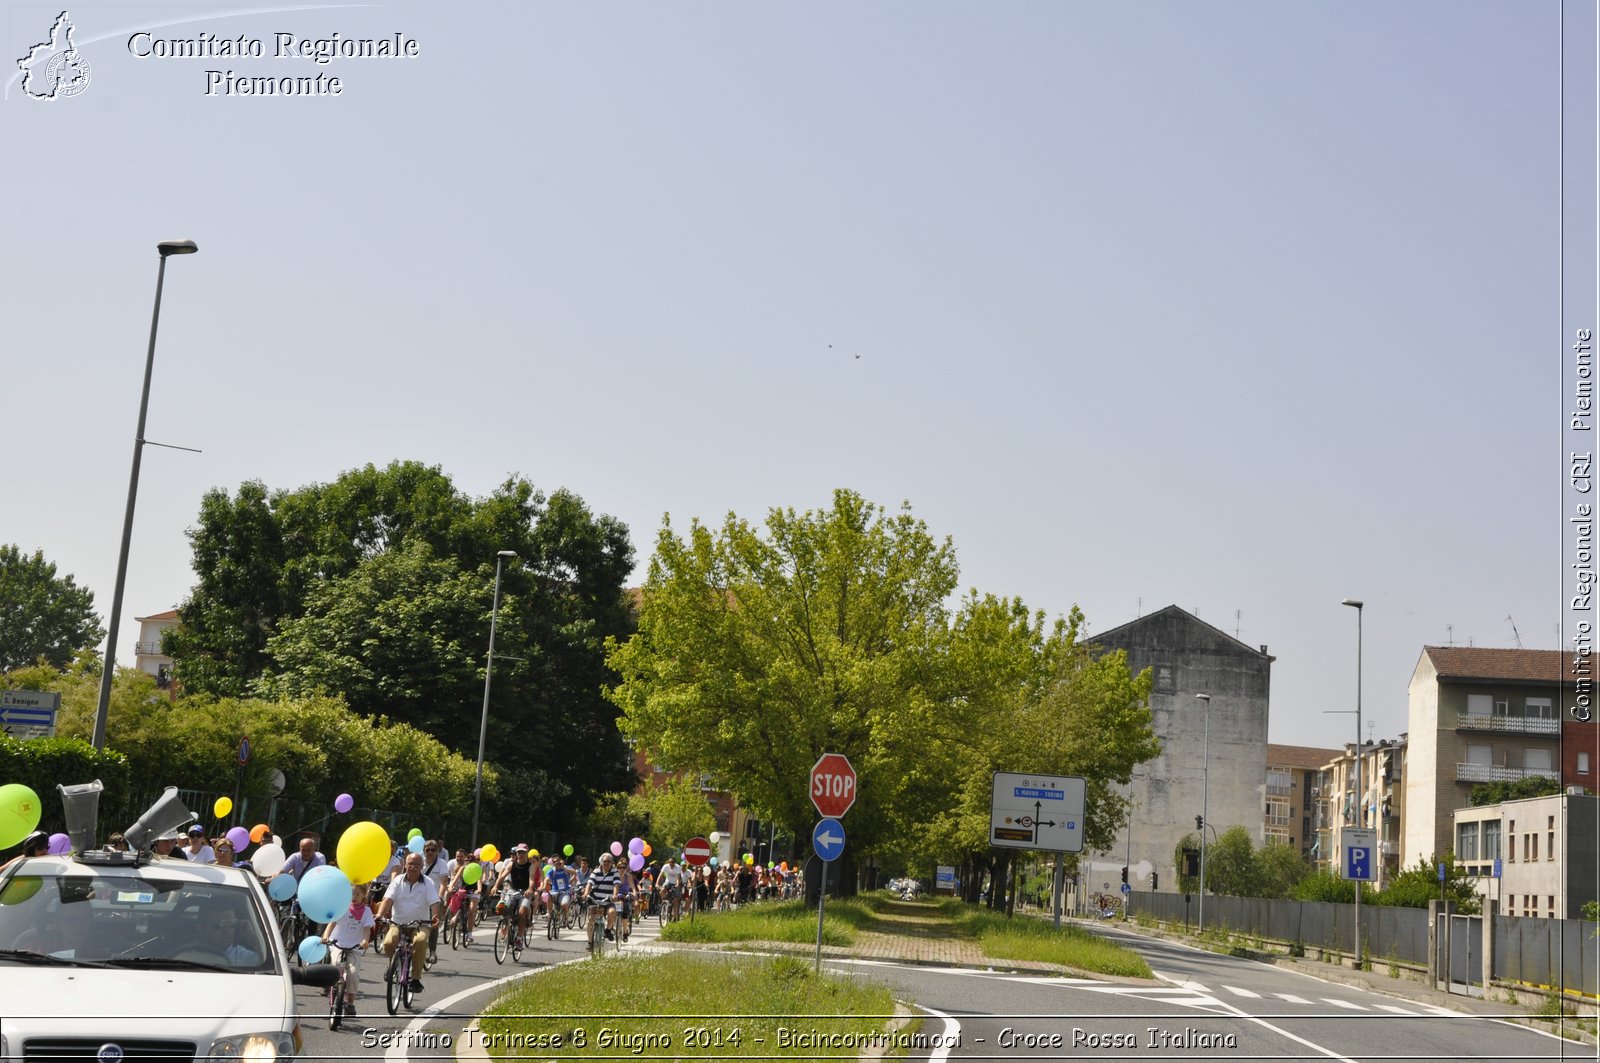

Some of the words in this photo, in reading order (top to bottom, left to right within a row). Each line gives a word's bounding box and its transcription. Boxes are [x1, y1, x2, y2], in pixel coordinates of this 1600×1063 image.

[12, 698, 39, 706] Benigno
[814, 773, 853, 798] STOP
[1353, 848, 1365, 865] P
